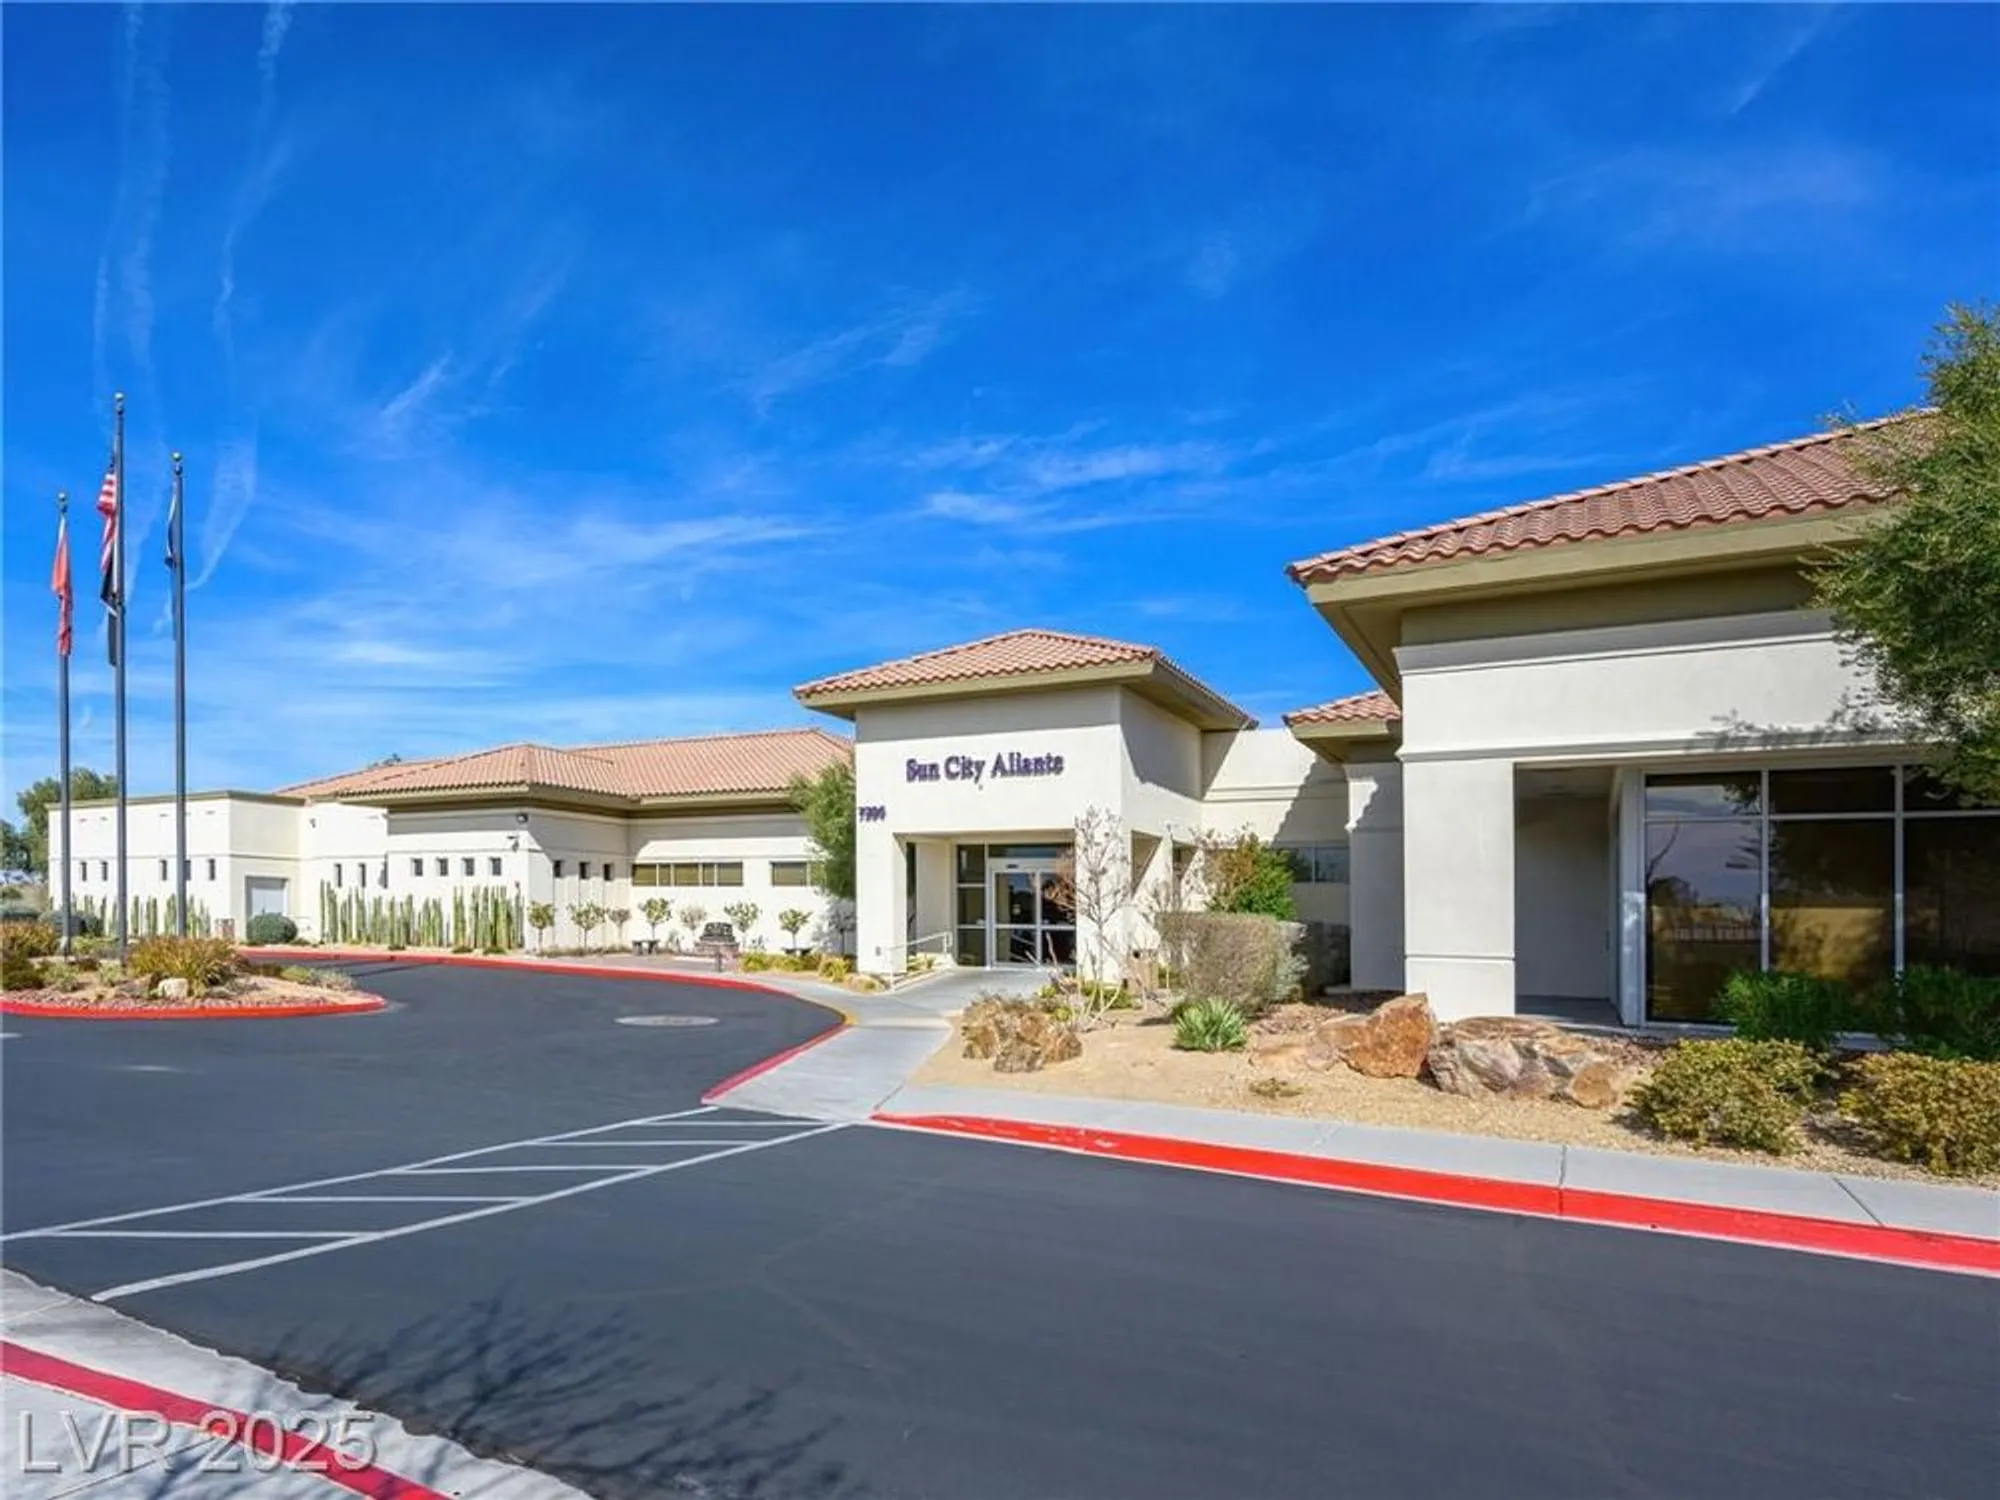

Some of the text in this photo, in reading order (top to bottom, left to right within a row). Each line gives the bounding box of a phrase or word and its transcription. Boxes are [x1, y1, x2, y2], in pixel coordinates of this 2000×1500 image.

[906, 752, 1064, 784] Sun City Aliante
